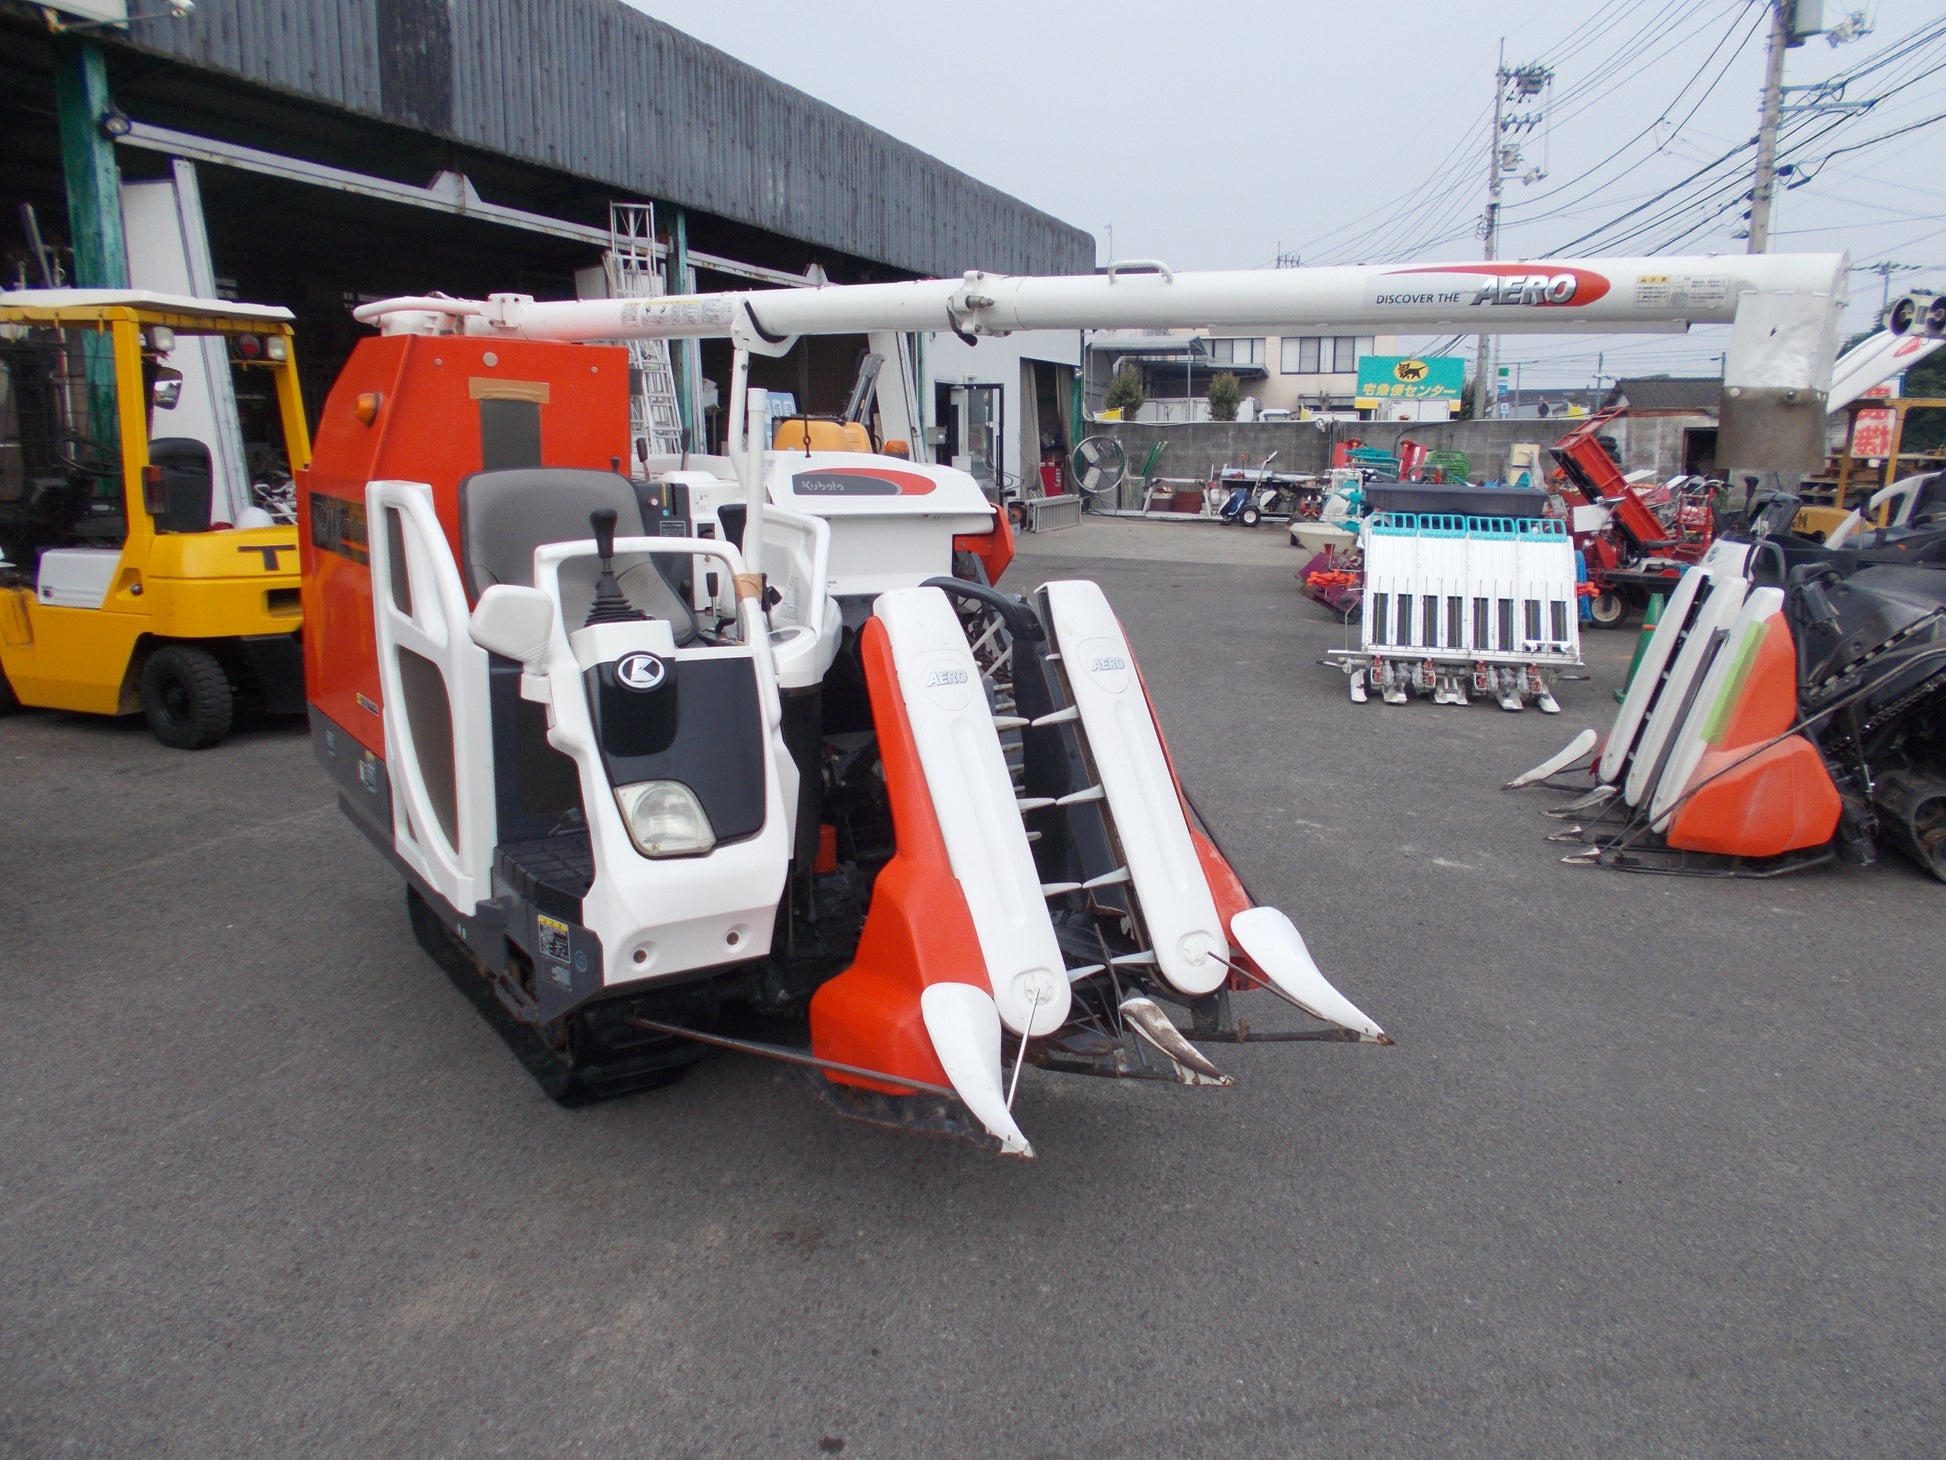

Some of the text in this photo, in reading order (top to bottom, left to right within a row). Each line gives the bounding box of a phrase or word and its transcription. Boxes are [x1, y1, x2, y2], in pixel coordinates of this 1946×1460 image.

[1376, 273, 1578, 306] DISCOVER THE AERO
[801, 479, 845, 491] Kubota
[1091, 656, 1126, 672] AERO
[927, 670, 968, 688] AERO
